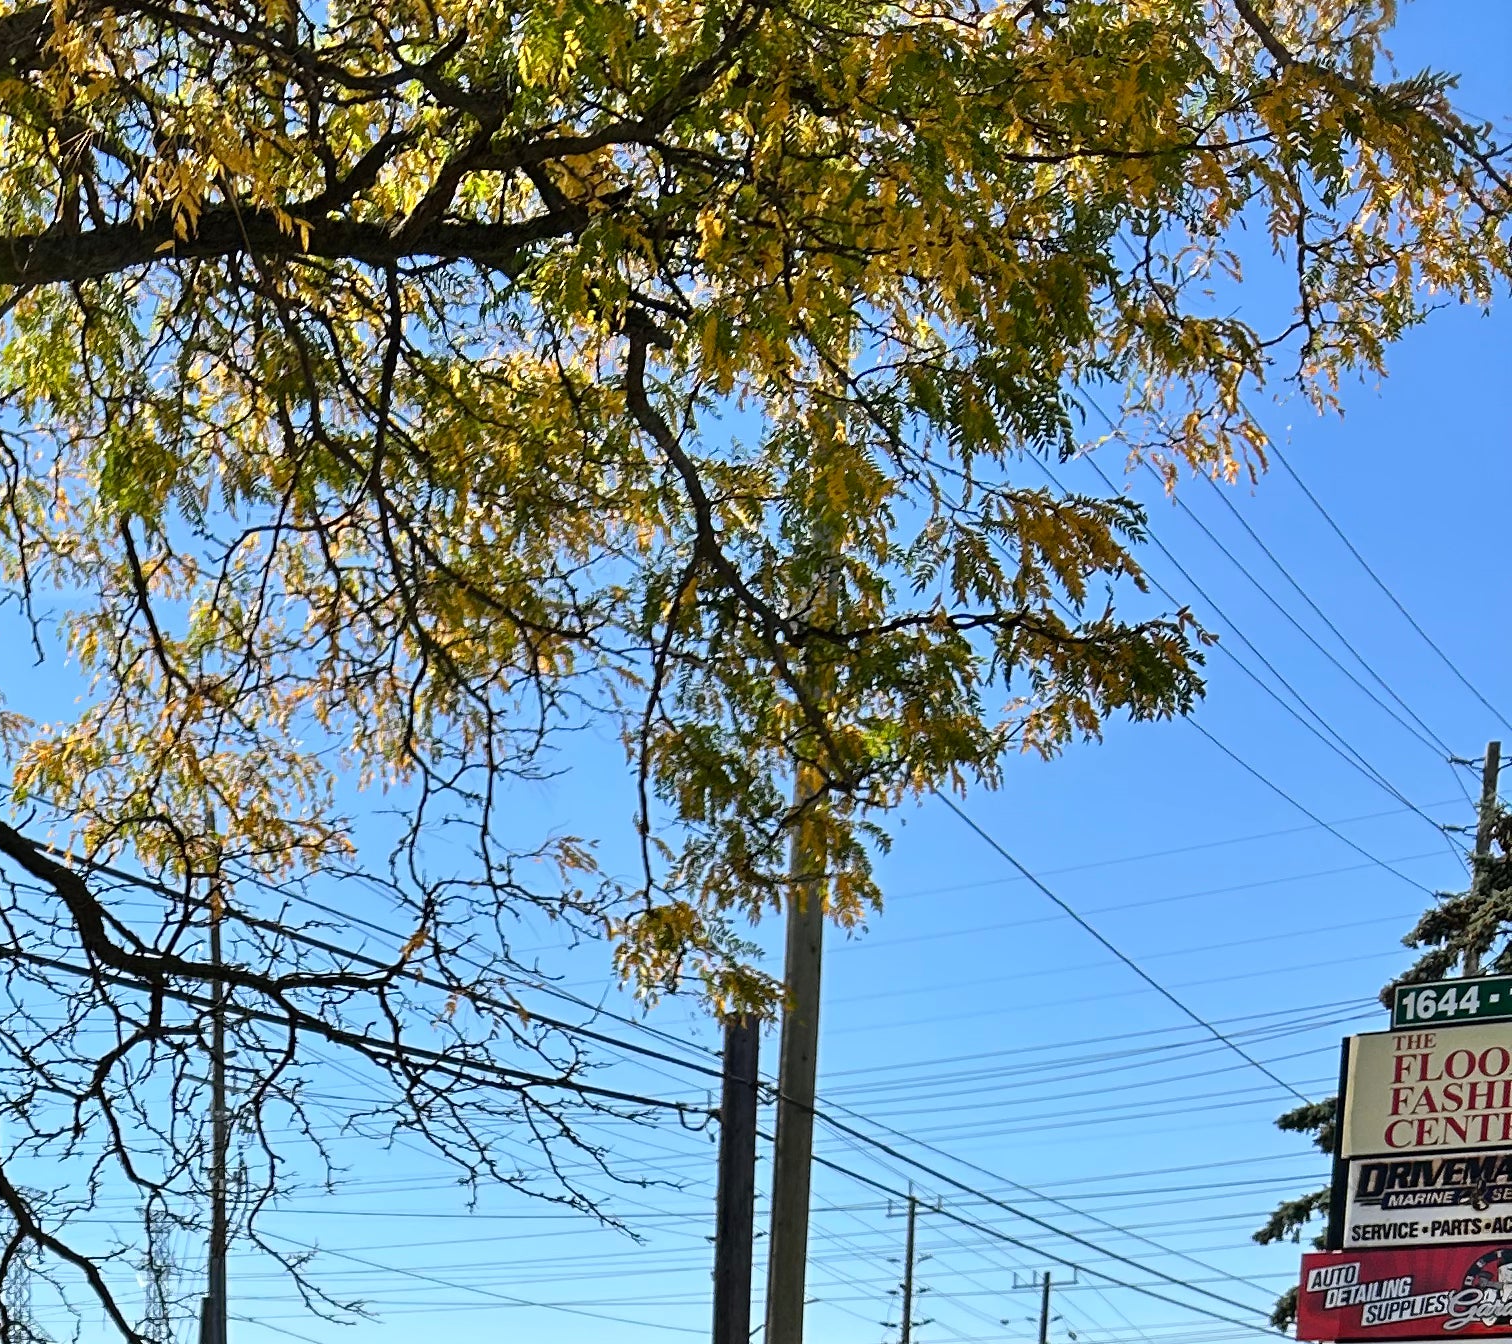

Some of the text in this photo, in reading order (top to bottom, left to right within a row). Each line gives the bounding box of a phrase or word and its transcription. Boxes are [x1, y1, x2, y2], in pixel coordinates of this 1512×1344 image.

[1402, 985, 1480, 1020] 1644
[1392, 1033, 1437, 1051] THE
[1389, 1046, 1512, 1084] FLOO
[1388, 1191, 1455, 1207] MARINE
[1351, 1221, 1419, 1242] SERVICE
[1431, 1218, 1482, 1237] PARTS
[1311, 1265, 1356, 1289] AUTO
[1325, 1277, 1412, 1309] DETAILING
[1366, 1294, 1447, 1324] SUPPLIES
